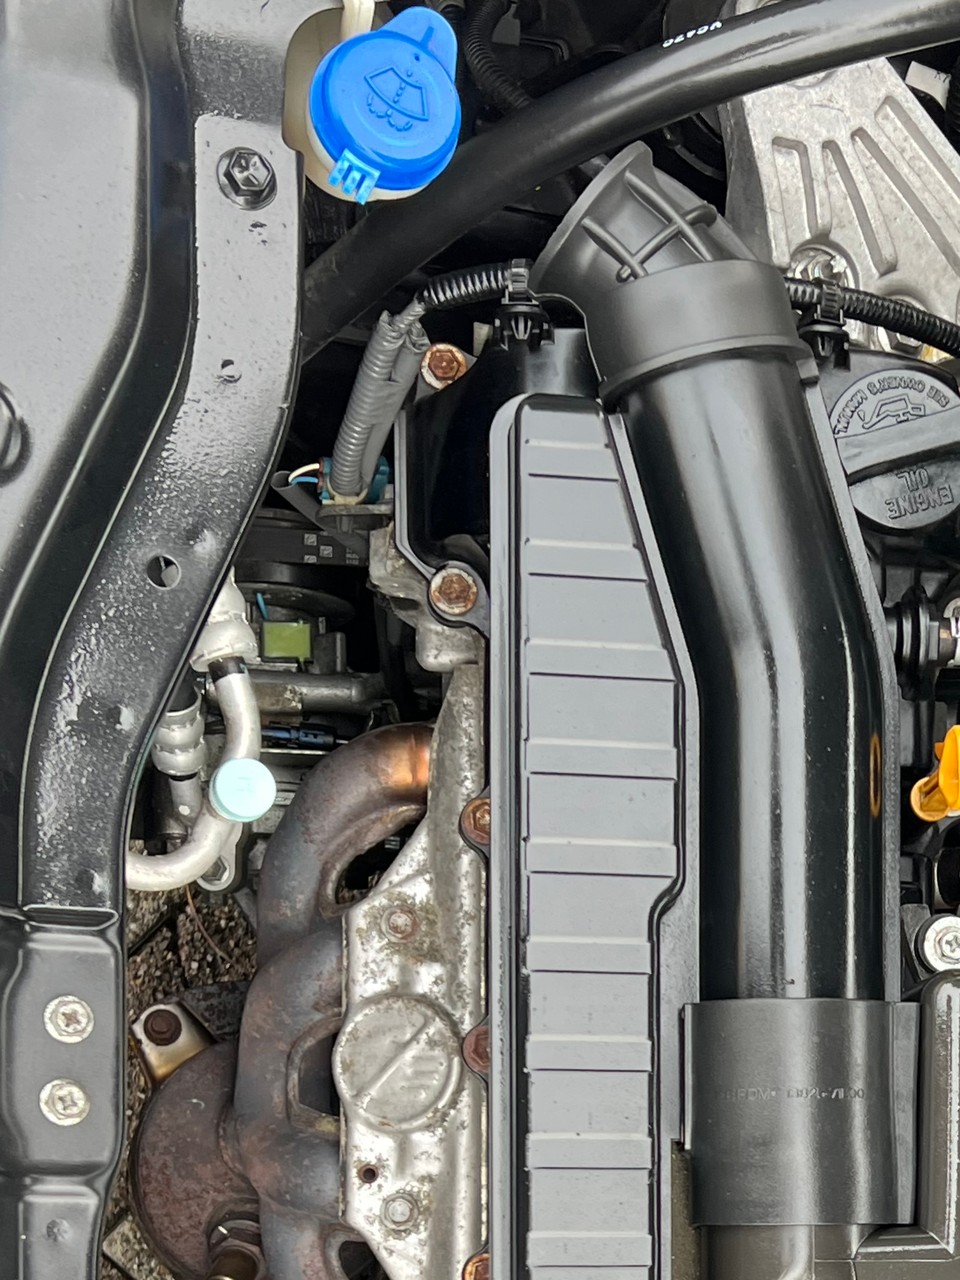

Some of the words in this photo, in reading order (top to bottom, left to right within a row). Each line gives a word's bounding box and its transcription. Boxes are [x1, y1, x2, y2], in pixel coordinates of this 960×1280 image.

[866, 375, 926, 396] OWNER'S
[926, 384, 951, 409] SEE
[831, 389, 869, 436] MANUAL
[895, 466, 931, 493] OIL
[884, 483, 956, 521] ENGINE
